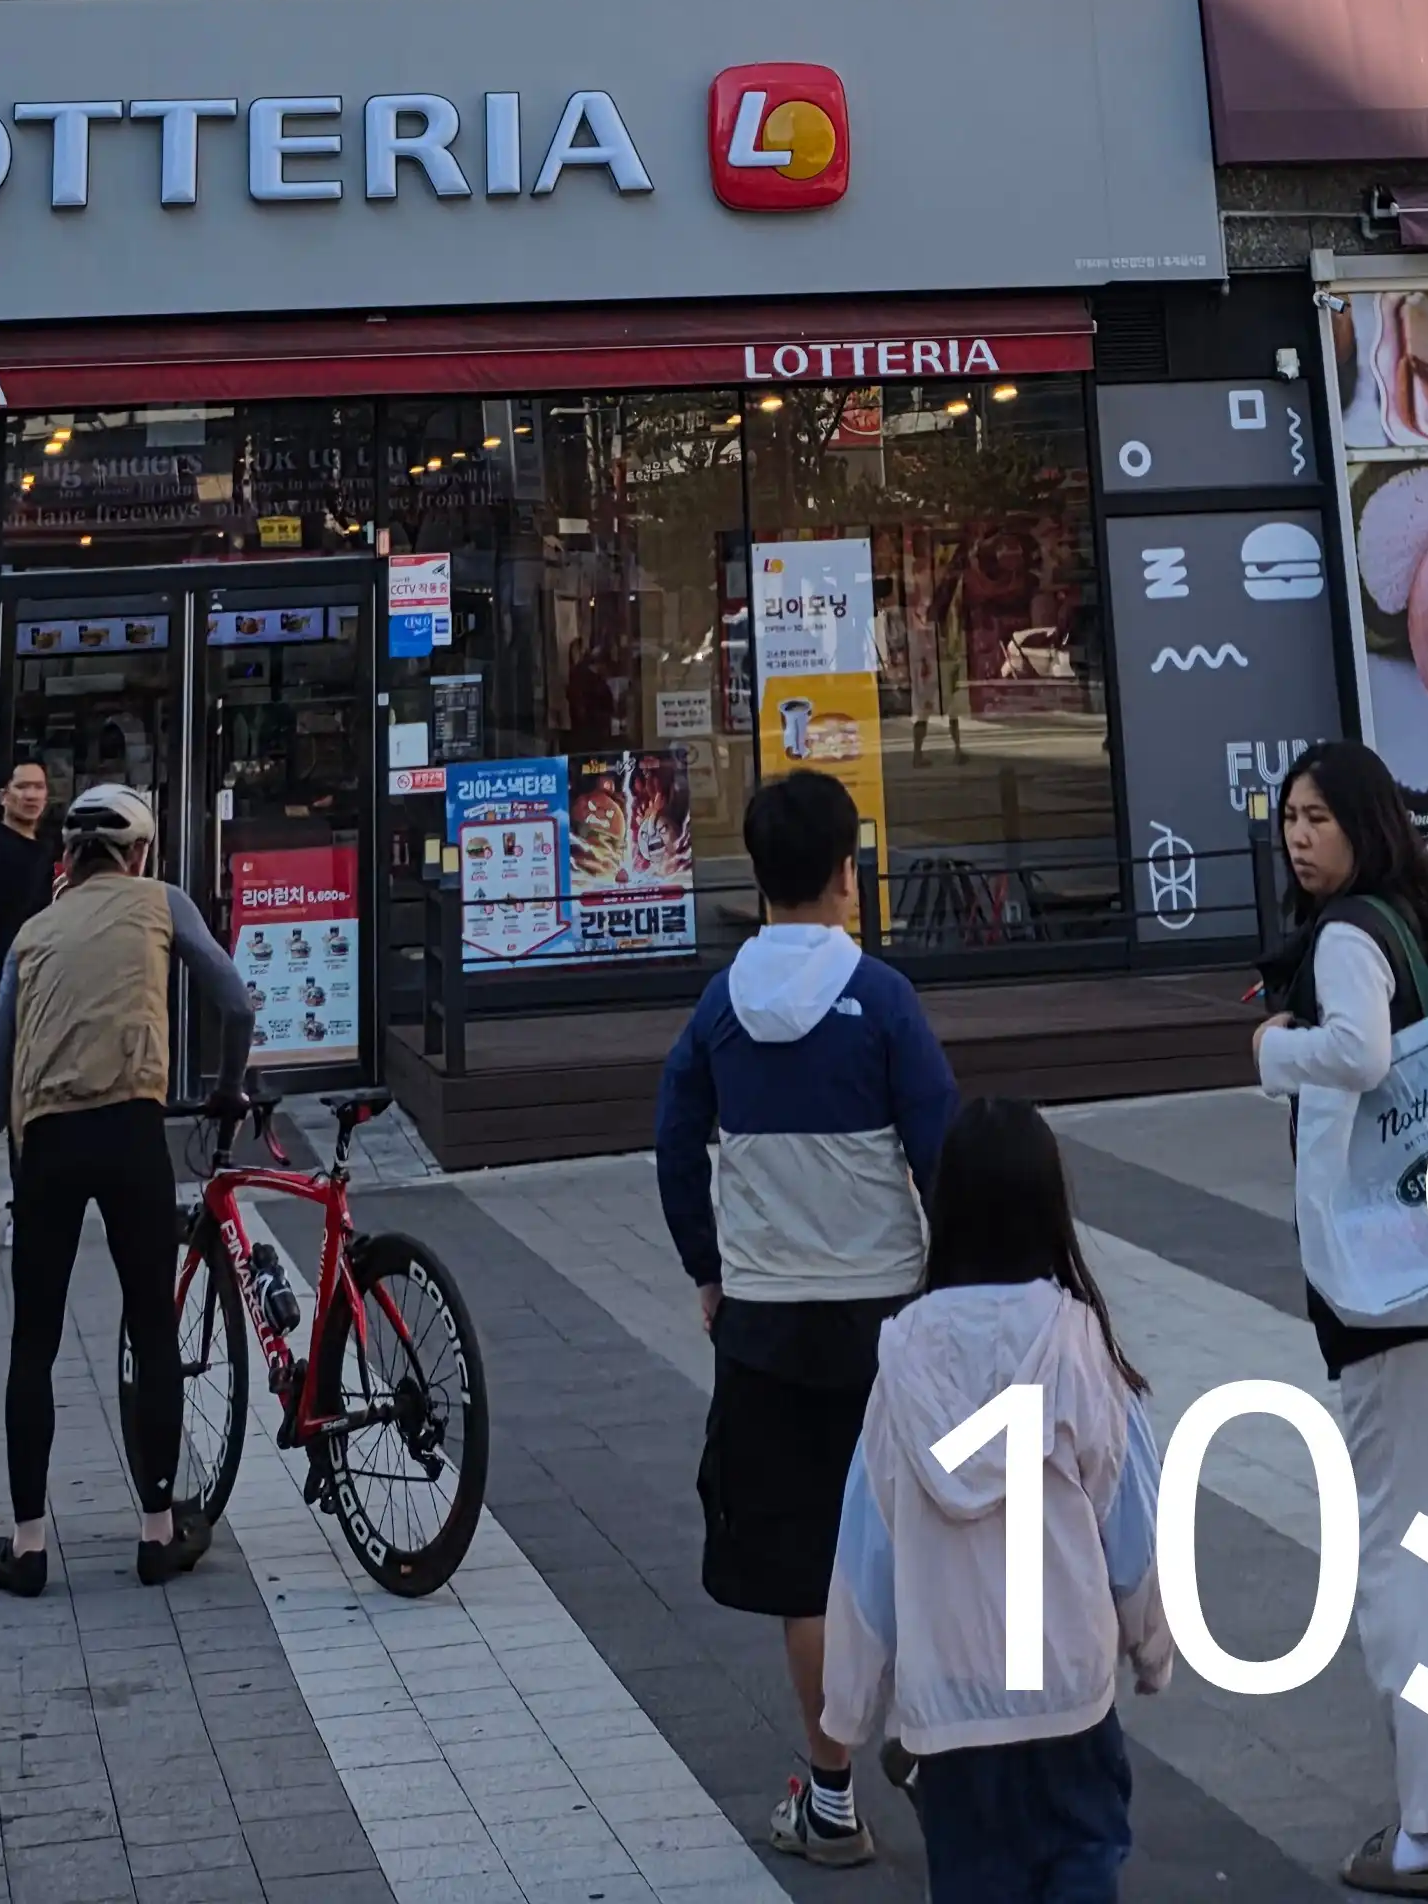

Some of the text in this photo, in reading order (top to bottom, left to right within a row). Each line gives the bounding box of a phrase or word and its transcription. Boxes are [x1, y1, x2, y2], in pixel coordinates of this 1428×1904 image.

[744, 337, 1000, 380] LOTTERIA
[390, 584, 417, 596] CCTV
[763, 593, 848, 621] 리아모닝
[458, 775, 557, 801] 리아스낵타임
[241, 884, 305, 909] 리아런치
[579, 904, 687, 940] 간판대결
